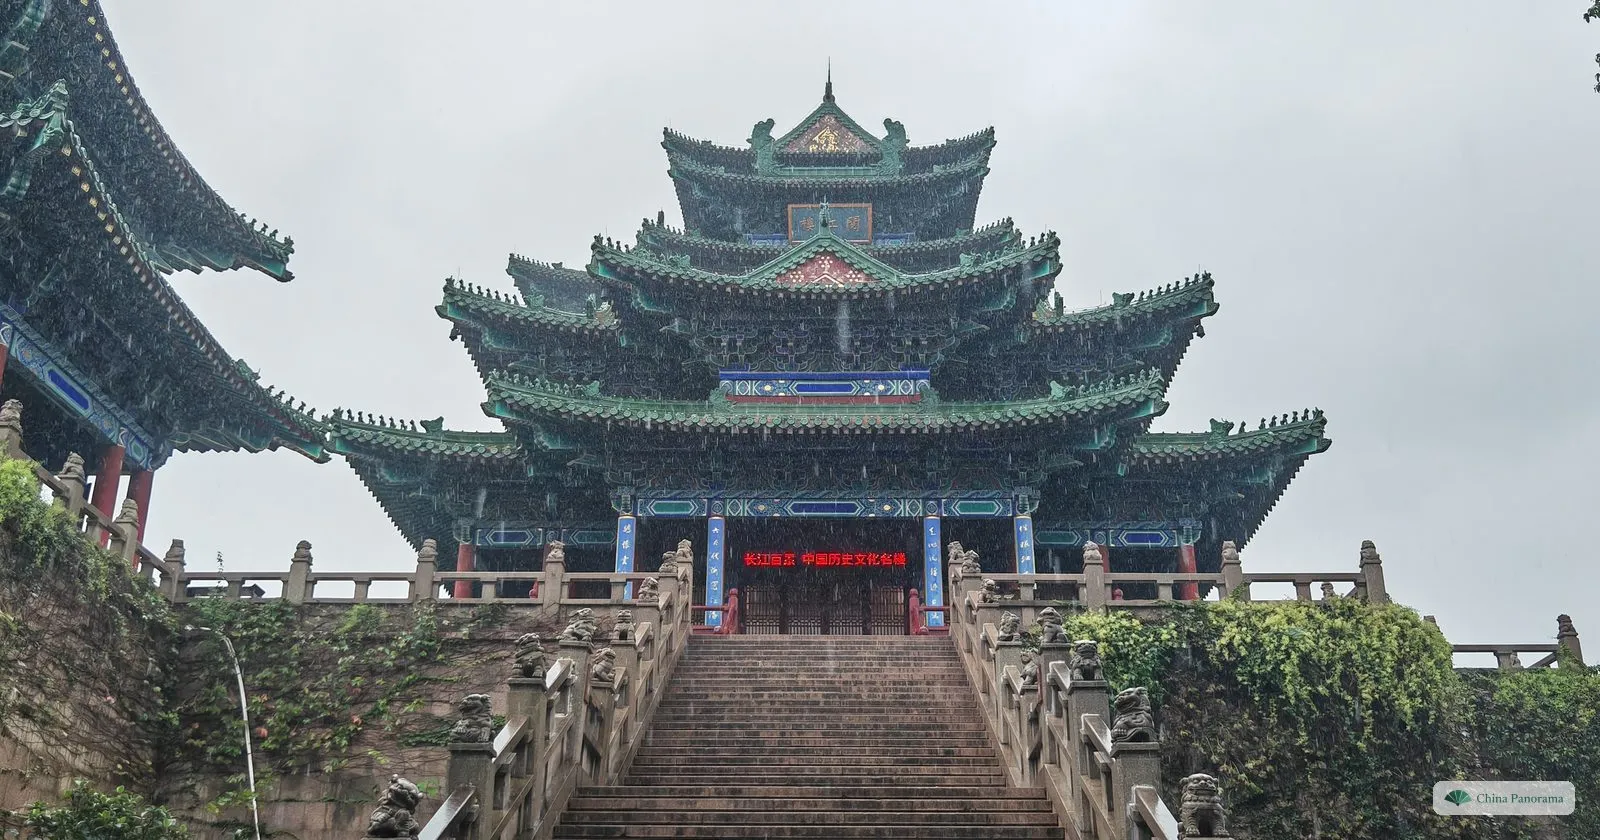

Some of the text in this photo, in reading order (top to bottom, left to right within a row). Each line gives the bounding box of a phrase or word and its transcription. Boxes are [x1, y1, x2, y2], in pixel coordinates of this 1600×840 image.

[801, 552, 907, 567] 中国历史文化名楼
